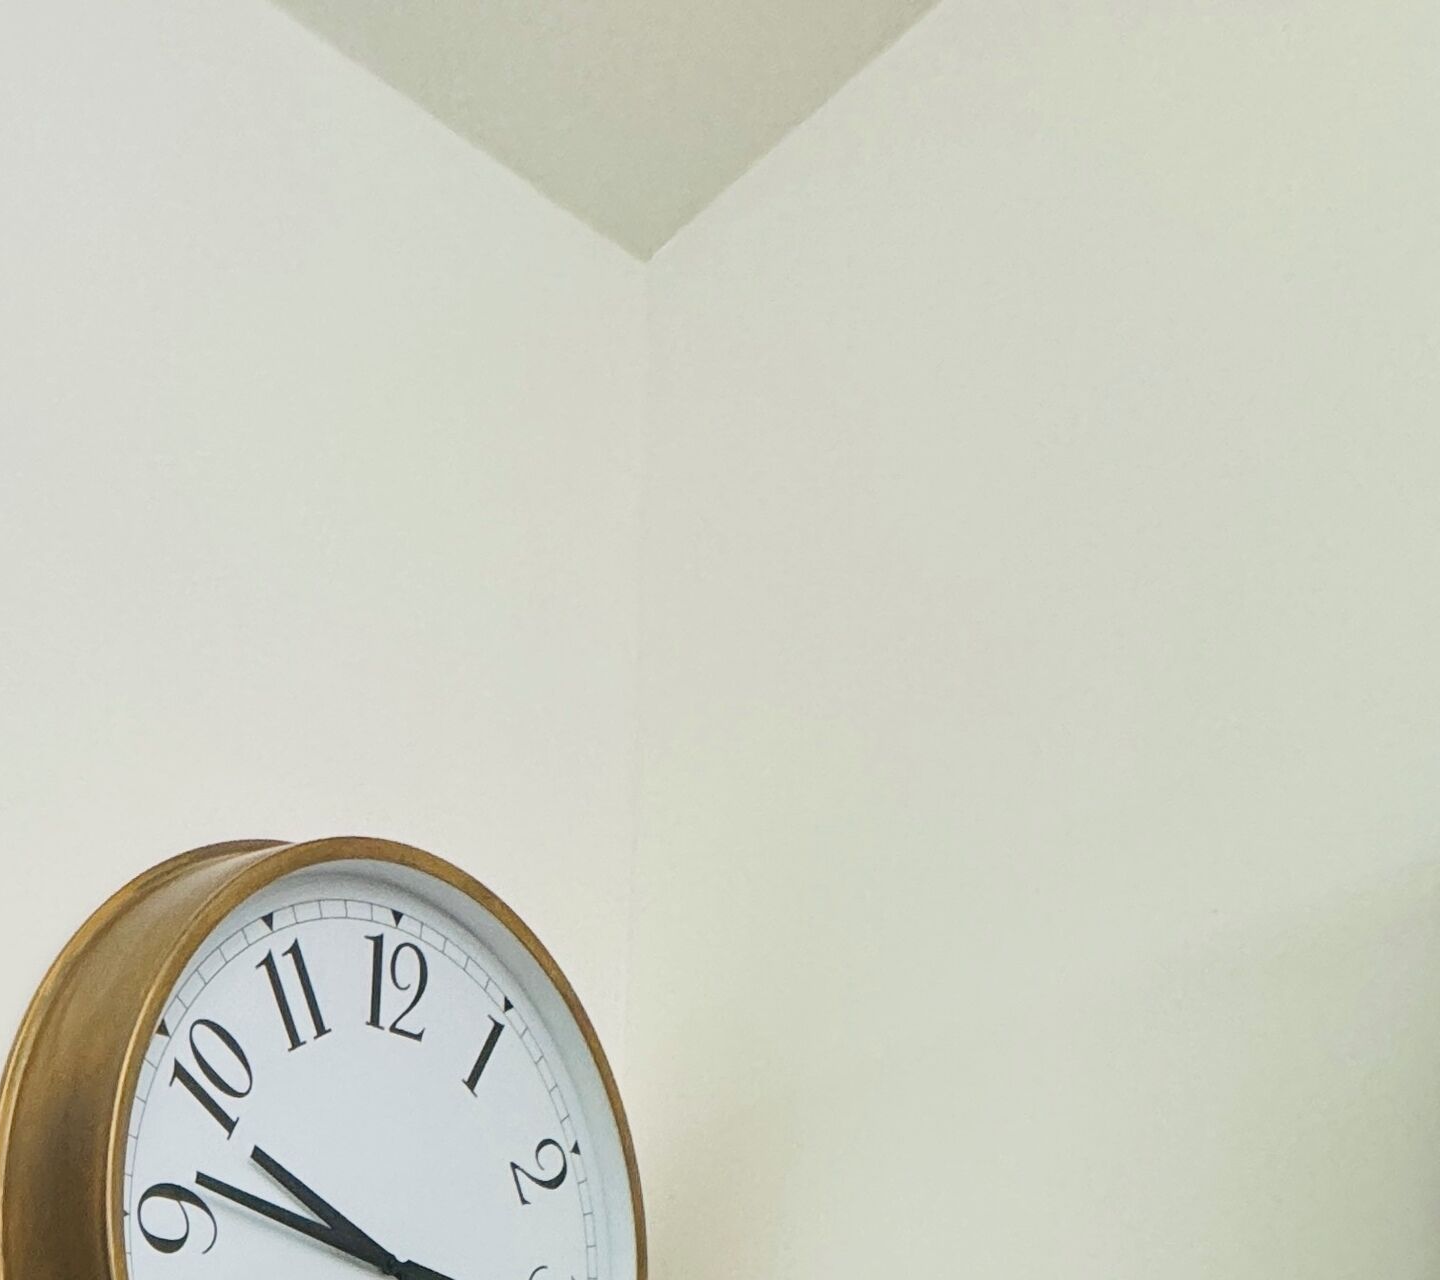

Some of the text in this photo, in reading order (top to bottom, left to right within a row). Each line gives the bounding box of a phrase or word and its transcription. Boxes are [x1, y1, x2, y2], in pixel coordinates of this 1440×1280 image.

[255, 937, 332, 1053] 11
[364, 932, 430, 1042] 12
[168, 1017, 254, 1141] 10
[461, 1014, 507, 1098] 1
[135, 1182, 219, 1256] 9
[509, 1137, 569, 1207] 2
